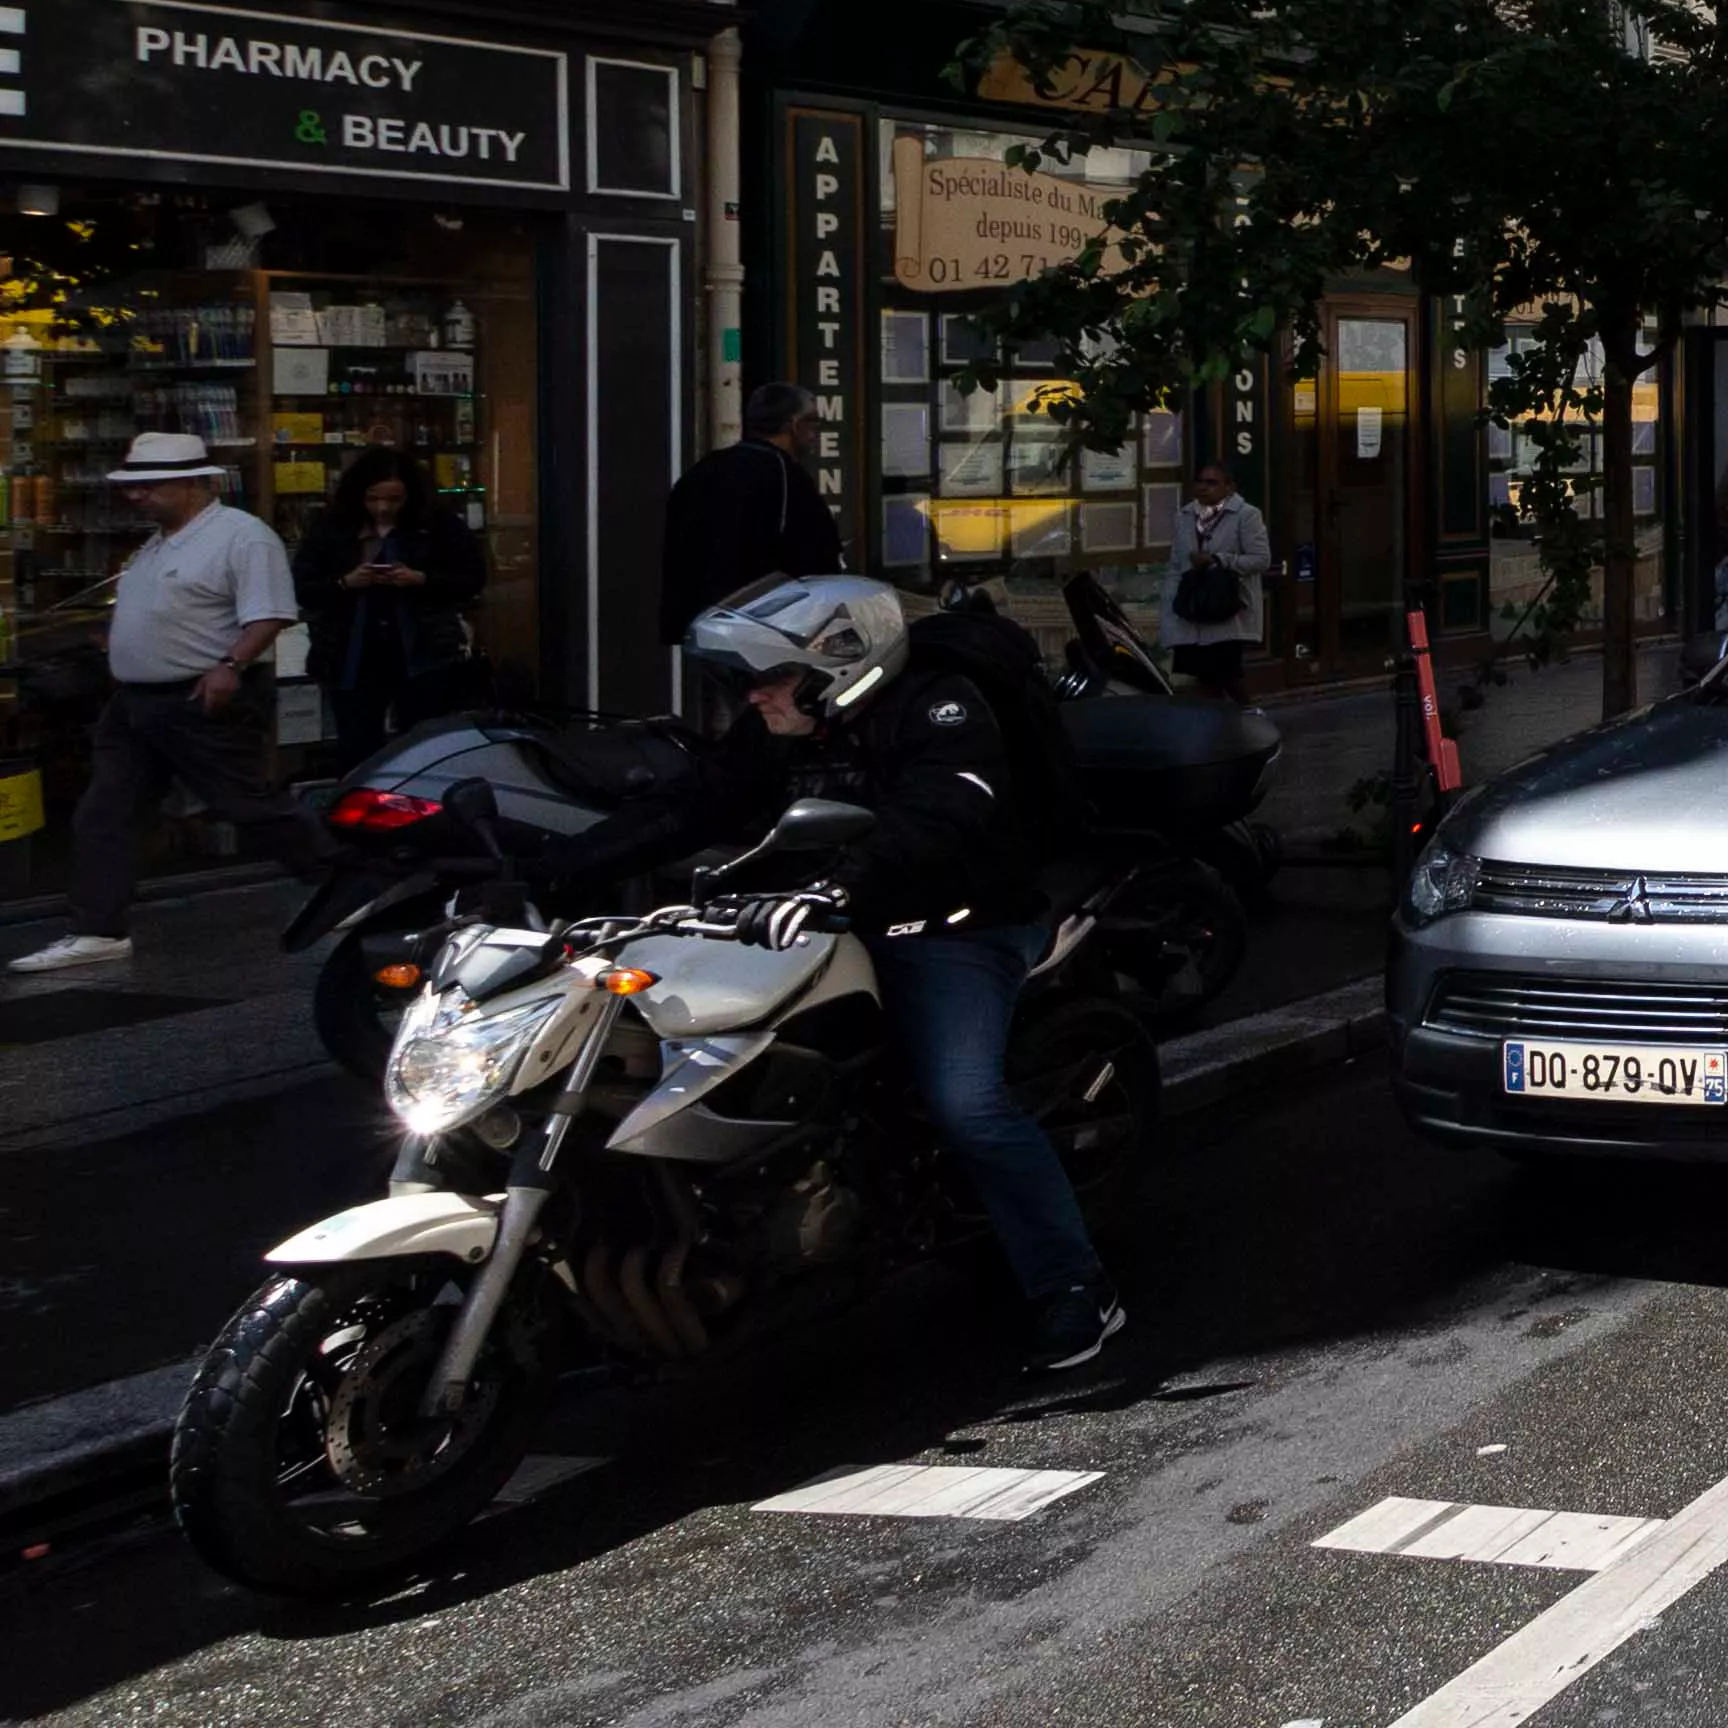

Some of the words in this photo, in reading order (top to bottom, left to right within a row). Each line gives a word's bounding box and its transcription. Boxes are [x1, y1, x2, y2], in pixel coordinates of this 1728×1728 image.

[136, 27, 423, 92] PHARMACY
[293, 109, 327, 146] &
[342, 114, 526, 162] BEAUTY
[929, 168, 1042, 203] Spécialiste
[1048, 186, 1071, 210] du
[1079, 194, 1104, 220] Ma
[976, 212, 1042, 242] depuis
[929, 257, 960, 282] 01
[976, 254, 1010, 279] 42
[814, 136, 842, 571] APPARTEMEN
[1511, 1072, 1519, 1084] F
[1529, 1050, 1698, 1096] DQ-879-QV
[1704, 1078, 1725, 1098] 75
